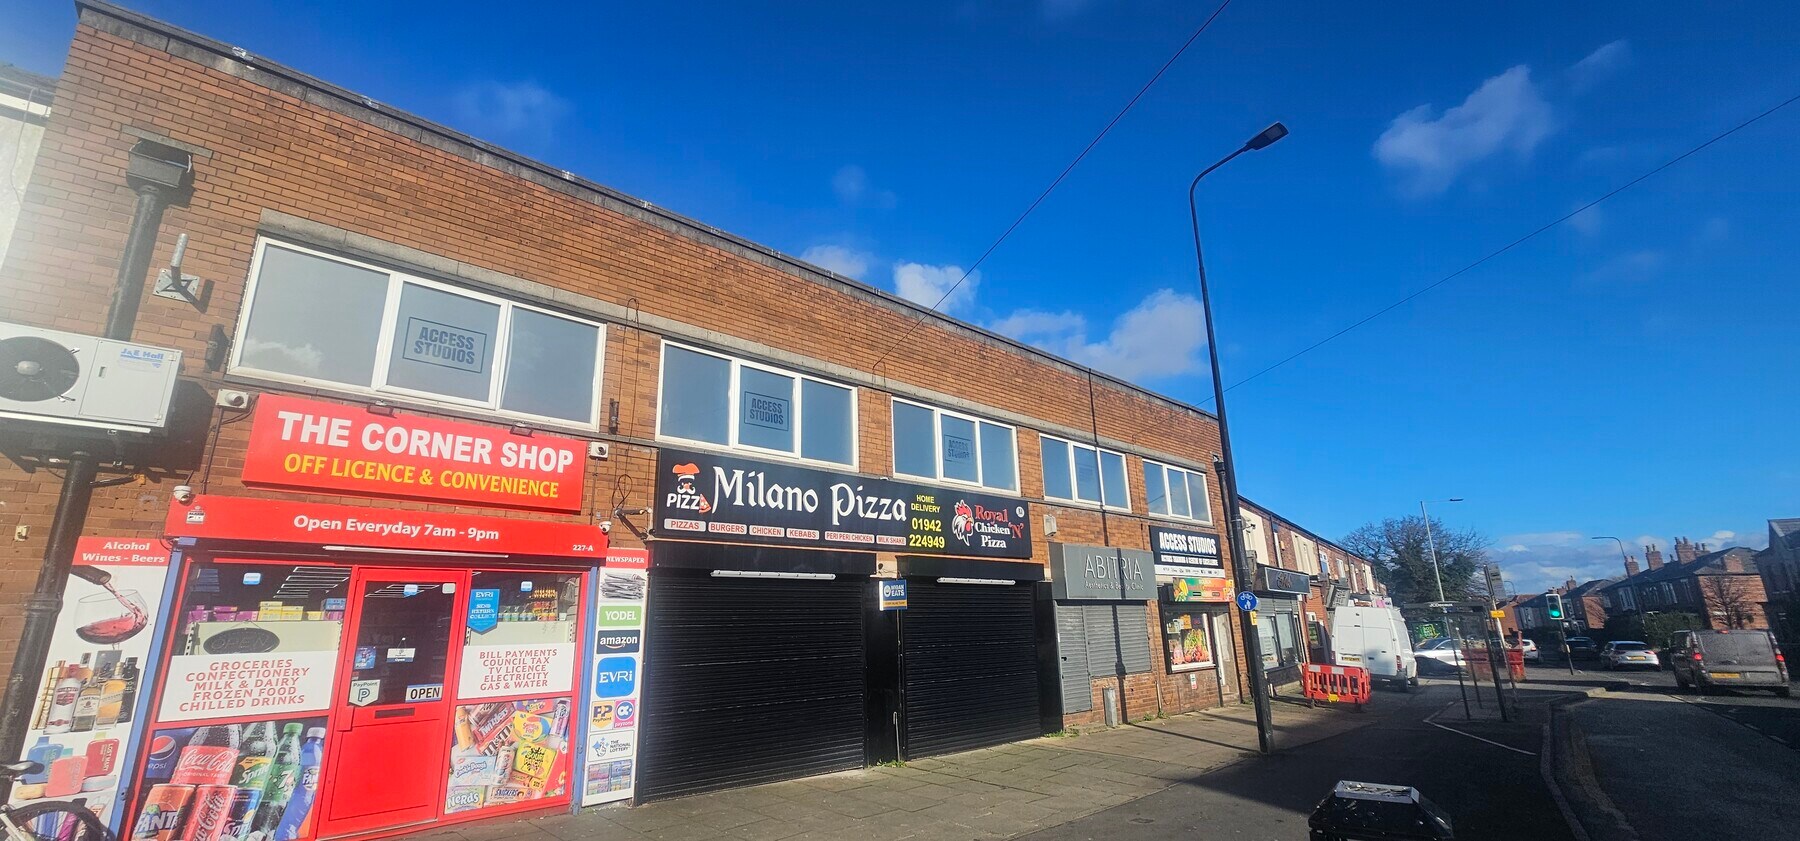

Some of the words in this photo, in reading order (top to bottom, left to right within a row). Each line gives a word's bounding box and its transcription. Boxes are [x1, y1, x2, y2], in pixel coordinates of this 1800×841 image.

[419, 326, 475, 350] ACCESS
[414, 340, 475, 365] STUDIOS
[751, 397, 782, 414] ACCESS
[750, 408, 784, 425] STUDIOS
[277, 410, 352, 448] THE
[361, 423, 493, 464] CORNER
[500, 441, 574, 473] SHOP
[284, 453, 327, 475] OFF
[330, 458, 415, 484] LICENCE
[419, 468, 434, 486] &
[440, 470, 560, 498] CONVENIENCE
[712, 466, 819, 514] Milano
[830, 483, 907, 526] Pizza
[916, 494, 935, 504] HOME
[910, 504, 941, 513] DELIVERY
[974, 504, 1009, 525] Royal
[293, 514, 342, 531] Open
[345, 519, 421, 537] Everyday
[424, 524, 456, 537] 7am
[467, 527, 500, 541] 9pm
[670, 520, 700, 530] PIZZAS
[710, 523, 745, 533] BURGERS
[751, 527, 782, 536] CHICKEN
[789, 529, 817, 539] KEBABS
[851, 534, 873, 542] CHICKEN
[911, 517, 942, 532] 01942
[974, 521, 1011, 535] Chicken
[103, 542, 151, 551] Alcohol
[572, 544, 594, 552] 227-A
[909, 534, 946, 549] 224949
[981, 534, 1007, 549] Pizza
[1158, 531, 1188, 552] ACCESS
[1188, 535, 1217, 555] STUDIOS
[82, 552, 121, 562] Wines
[131, 554, 165, 563] Beers
[606, 555, 645, 564] NEWSPAPER
[1084, 554, 1144, 581] ABITRIA
[605, 611, 637, 621] YODEL
[600, 636, 638, 645] amazon
[479, 651, 502, 659] BILL
[505, 649, 558, 658] PAYMENTS
[209, 659, 293, 671] GROCERIES
[483, 658, 528, 667] COUNCIL
[531, 656, 550, 665] TAX
[505, 664, 547, 673] LICENCE
[185, 667, 310, 682] CONFECTIONERY
[484, 672, 549, 682] ELECTRICITY
[193, 681, 234, 691] MILK
[238, 680, 249, 689] &
[254, 677, 299, 688] DAIRY
[480, 682, 501, 691] GAS
[514, 679, 548, 688] WATER
[192, 689, 253, 701] FROZEN
[258, 687, 297, 697] FOOD
[410, 687, 440, 700] OPEN
[179, 699, 246, 712] CHILLED
[251, 695, 305, 707] DRINKS
[148, 762, 167, 770] epsi
